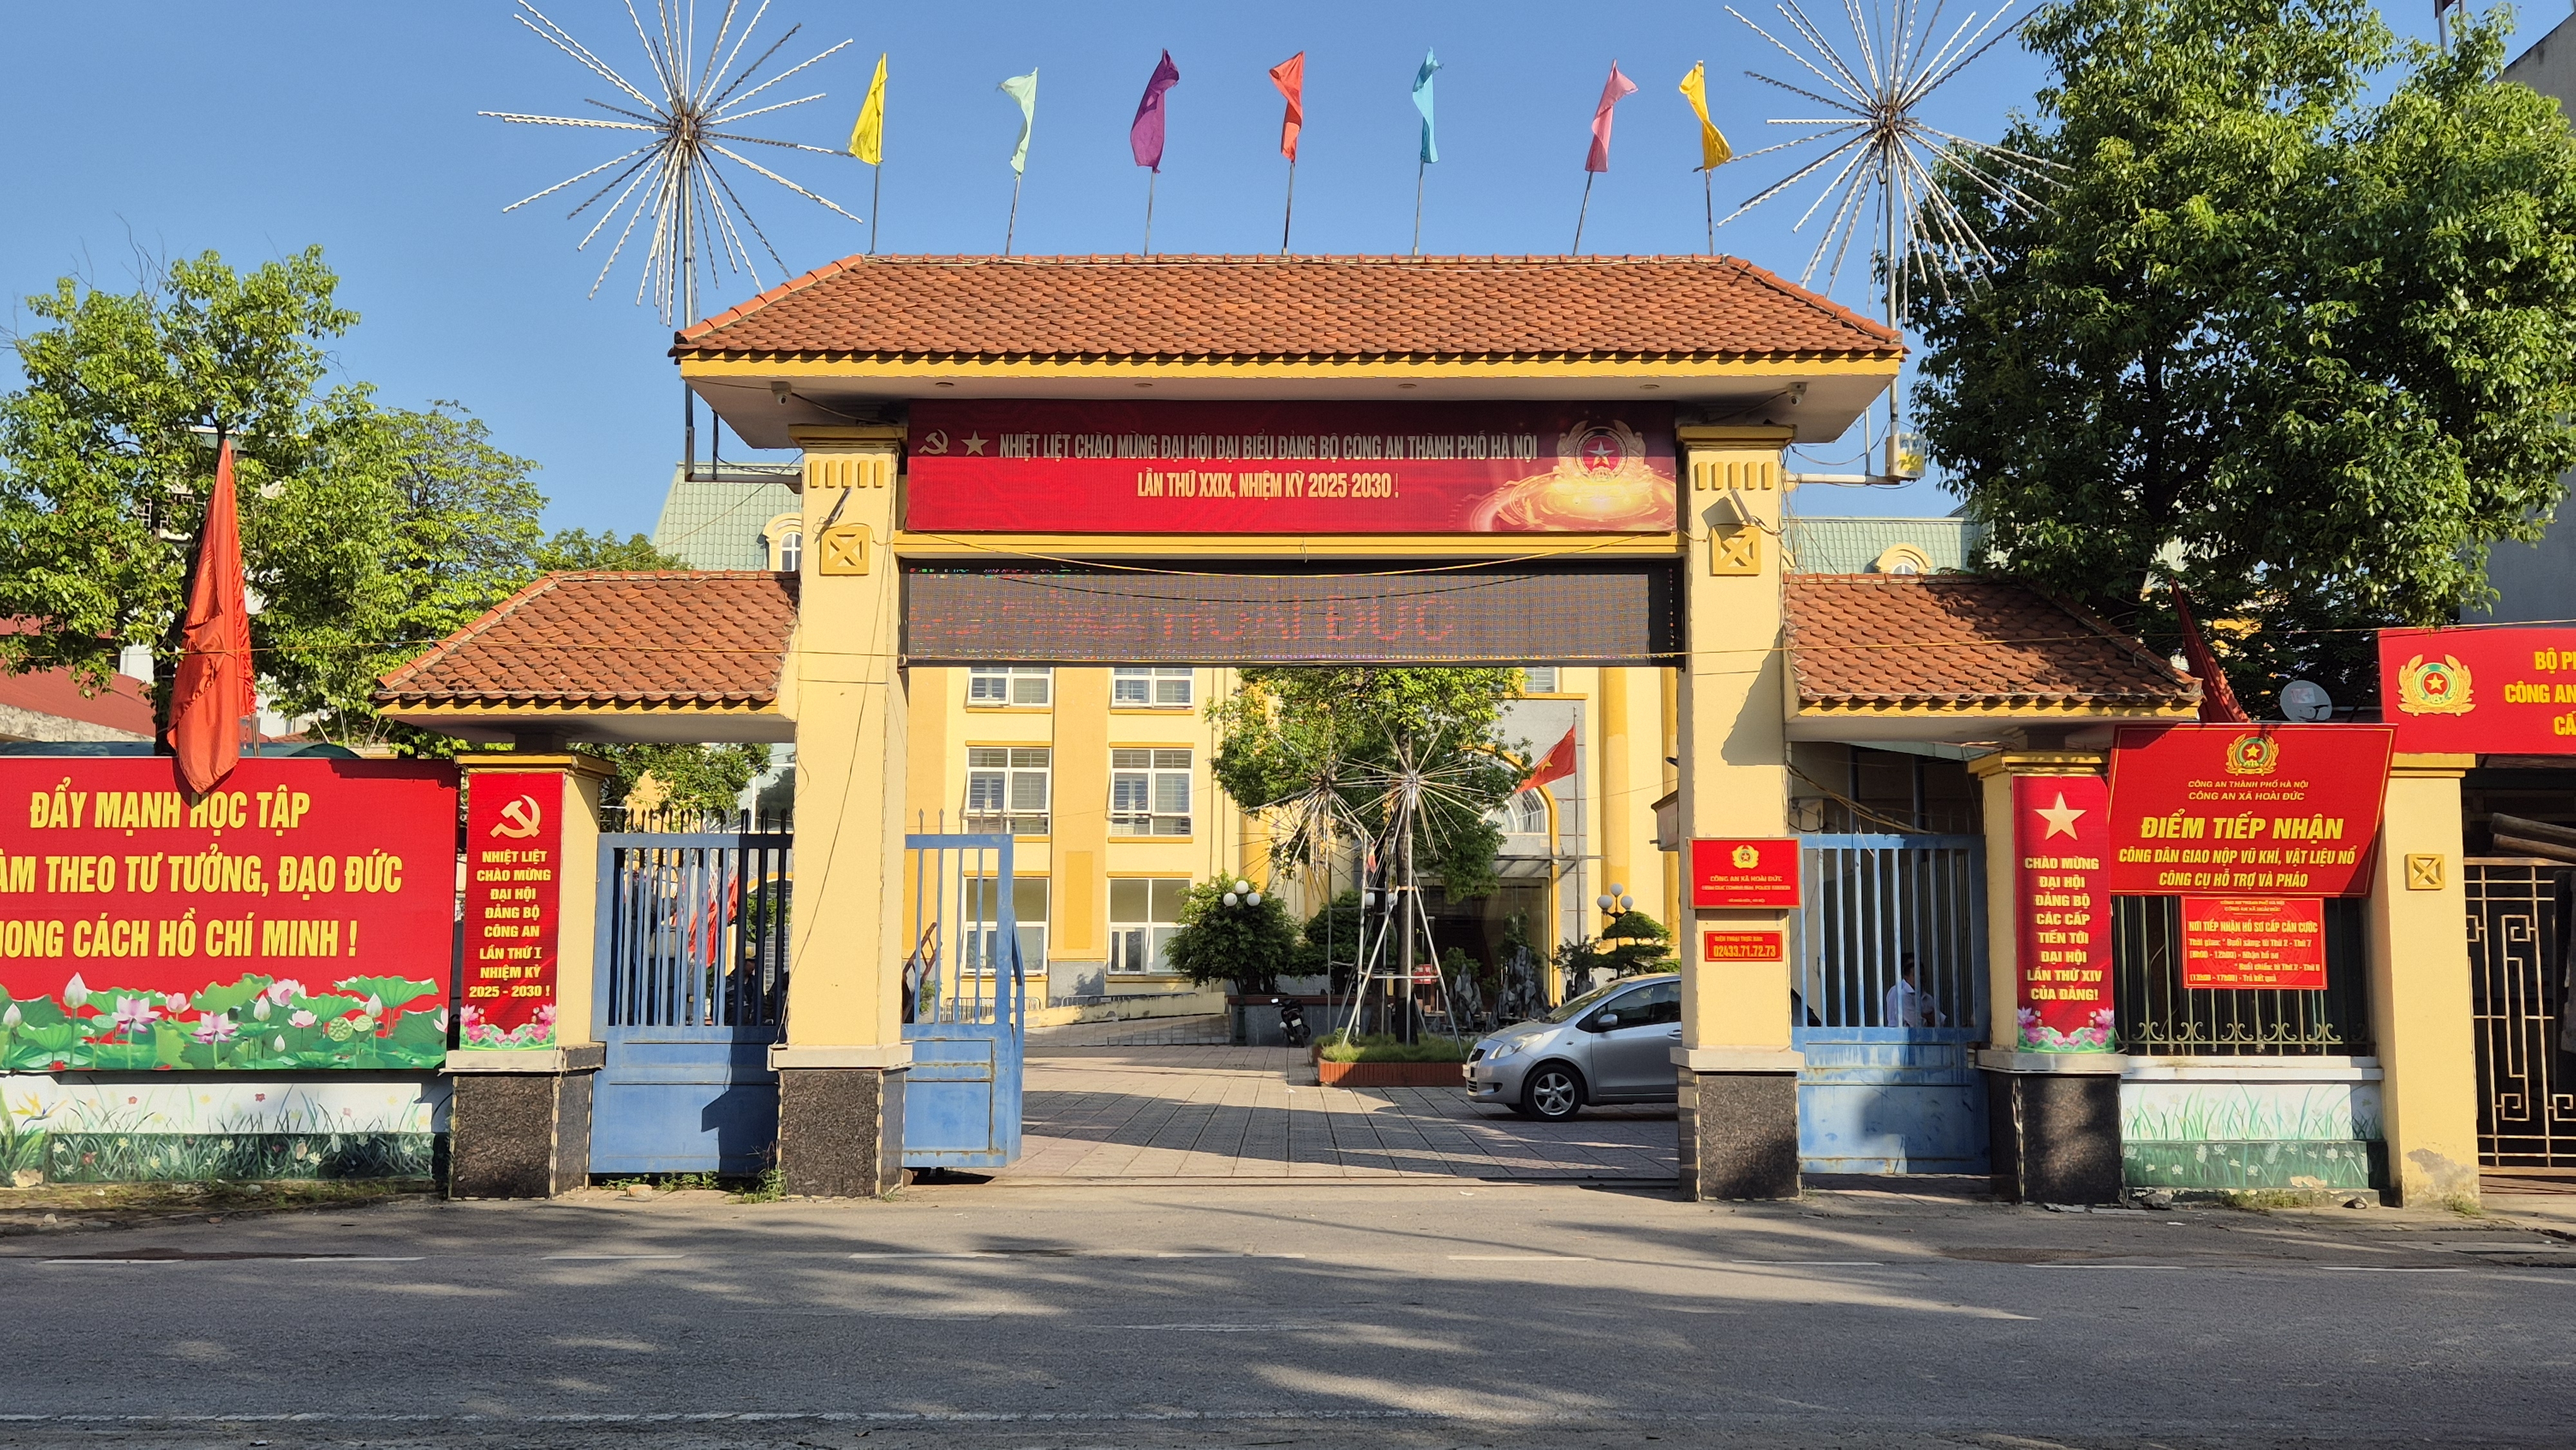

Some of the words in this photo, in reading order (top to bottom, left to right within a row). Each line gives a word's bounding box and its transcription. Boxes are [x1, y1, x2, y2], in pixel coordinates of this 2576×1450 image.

[1000, 431, 1039, 462] NHIỆT
[1044, 431, 1070, 462] LIỆT
[1075, 431, 1113, 458] CHÀO
[1117, 429, 1157, 458] MỪNG
[1161, 434, 1184, 462] ĐẠI
[1188, 432, 1211, 462] HỘI
[1216, 435, 1238, 463] ĐẠI
[1243, 428, 1274, 459] BIỂU
[1278, 430, 1315, 460] ĐẢNG
[1320, 433, 1339, 463] BỘ
[1343, 432, 1381, 459] CÔNG
[1385, 436, 1403, 459] AN
[1408, 433, 1454, 459] THÀNH
[1458, 430, 1486, 459] PHỐ
[1491, 432, 1510, 459] HÀ
[1514, 432, 1537, 463] NỘI
[1137, 467, 1164, 497] LẦN
[1166, 469, 1197, 498] THỨ
[1198, 472, 1236, 499] XXIX,
[1238, 469, 1282, 501] NHIỆM
[1285, 469, 1305, 498] KỲ
[1307, 472, 1392, 498] 2025-2030
[1394, 473, 1399, 498] !
[2533, 647, 2558, 674] BỘ
[2505, 680, 2550, 704] CÔNG
[2553, 684, 2576, 704] AN
[2188, 779, 2213, 788] CÔNG
[2229, 780, 2259, 788] THÀNH
[2259, 779, 2278, 788] PHỐ
[2279, 780, 2292, 788] HÀ
[2293, 780, 2309, 789] NỘI
[2188, 790, 2219, 800] CÔNG
[2221, 792, 2236, 800] AN
[2238, 791, 2253, 800] XÃ
[2255, 790, 2280, 800] HOÀI
[2282, 790, 2305, 800] ĐỨC
[30, 777, 87, 828] ĐẨY
[95, 791, 181, 836] MẠNH
[189, 791, 247, 836] HỌC
[256, 784, 310, 836] TẬP
[2141, 808, 2206, 839] ĐIỂM
[2213, 811, 2266, 839] TIẾP
[2272, 813, 2344, 844] NHẬN
[482, 849, 519, 865] NHIỆT
[521, 848, 547, 865] LIỆT
[2025, 855, 2058, 869] CHÀO
[2060, 855, 2099, 870] MỪNG
[2118, 845, 2152, 863] CÔNG
[2154, 846, 2180, 863] DÂN
[2182, 849, 2210, 864] GIAO
[2211, 847, 2238, 867] NỘP
[2240, 847, 2257, 864] VŨ
[2258, 847, 2282, 866] KHÍ,
[2286, 847, 2308, 867] VẬT
[2309, 847, 2336, 867] LIỆU
[2337, 845, 2357, 865] NỔ
[45, 855, 116, 893] THEO
[124, 851, 164, 893] TƯ
[167, 843, 269, 898] TƯỞNG,
[278, 855, 336, 901] ĐẠO
[344, 848, 402, 893] ĐỨC
[476, 867, 511, 881] CHÀO
[513, 867, 552, 881] MỪNG
[2159, 869, 2192, 886] CÔNG
[2194, 872, 2211, 889] CỤ
[2213, 868, 2230, 887] HỖ
[2233, 871, 2257, 890] TRỢ
[2258, 871, 2273, 887] VÀ
[2275, 871, 2308, 888] PHÁO
[2038, 876, 2061, 890] ĐẠI
[2062, 874, 2085, 890] HỘI
[489, 888, 512, 903] ĐẠI
[515, 886, 536, 902] HỘI
[2034, 891, 2070, 907] ĐẢNG
[2072, 892, 2090, 909] BỘ
[484, 903, 520, 919] ĐẢNG
[522, 904, 540, 921] BỘ
[2036, 910, 2062, 925] CÁC
[2064, 910, 2090, 925] CẤP
[0, 920, 64, 958] ONG
[73, 912, 150, 958] CÁCH
[157, 907, 196, 957] HỒ
[205, 912, 255, 957] CHÍ
[261, 920, 339, 957] MINH
[348, 920, 357, 957] !
[484, 923, 519, 937] CÔNG
[521, 925, 540, 937] AN
[2188, 921, 2202, 931] NƠI
[2203, 918, 2219, 932] TIẾP
[2221, 919, 2241, 934] NHẬN
[2254, 921, 2264, 932] SƠ
[2265, 918, 2280, 932] CẤP
[2282, 919, 2297, 932] CĂN
[2298, 920, 2318, 933] CƯỚC
[2037, 928, 2067, 944] TIẾN
[2067, 930, 2089, 945] TỚI
[479, 944, 505, 960] LẦN
[507, 945, 533, 959] THỨ
[1714, 945, 1776, 957] 02433.71.72.73
[2040, 950, 2063, 965] ĐẠI
[2064, 948, 2087, 966] HỘI
[480, 964, 522, 981] NHIỆM
[524, 964, 542, 979] KỲ
[2027, 965, 2052, 981] LẦN
[2054, 967, 2080, 982] THỨ
[2080, 970, 2103, 982] XIV
[468, 985, 500, 998] 2025
[511, 985, 542, 997] 2030
[545, 984, 550, 997] !
[2031, 984, 2057, 1000] CỦA
[2058, 984, 2099, 1001] ĐẢNG!
